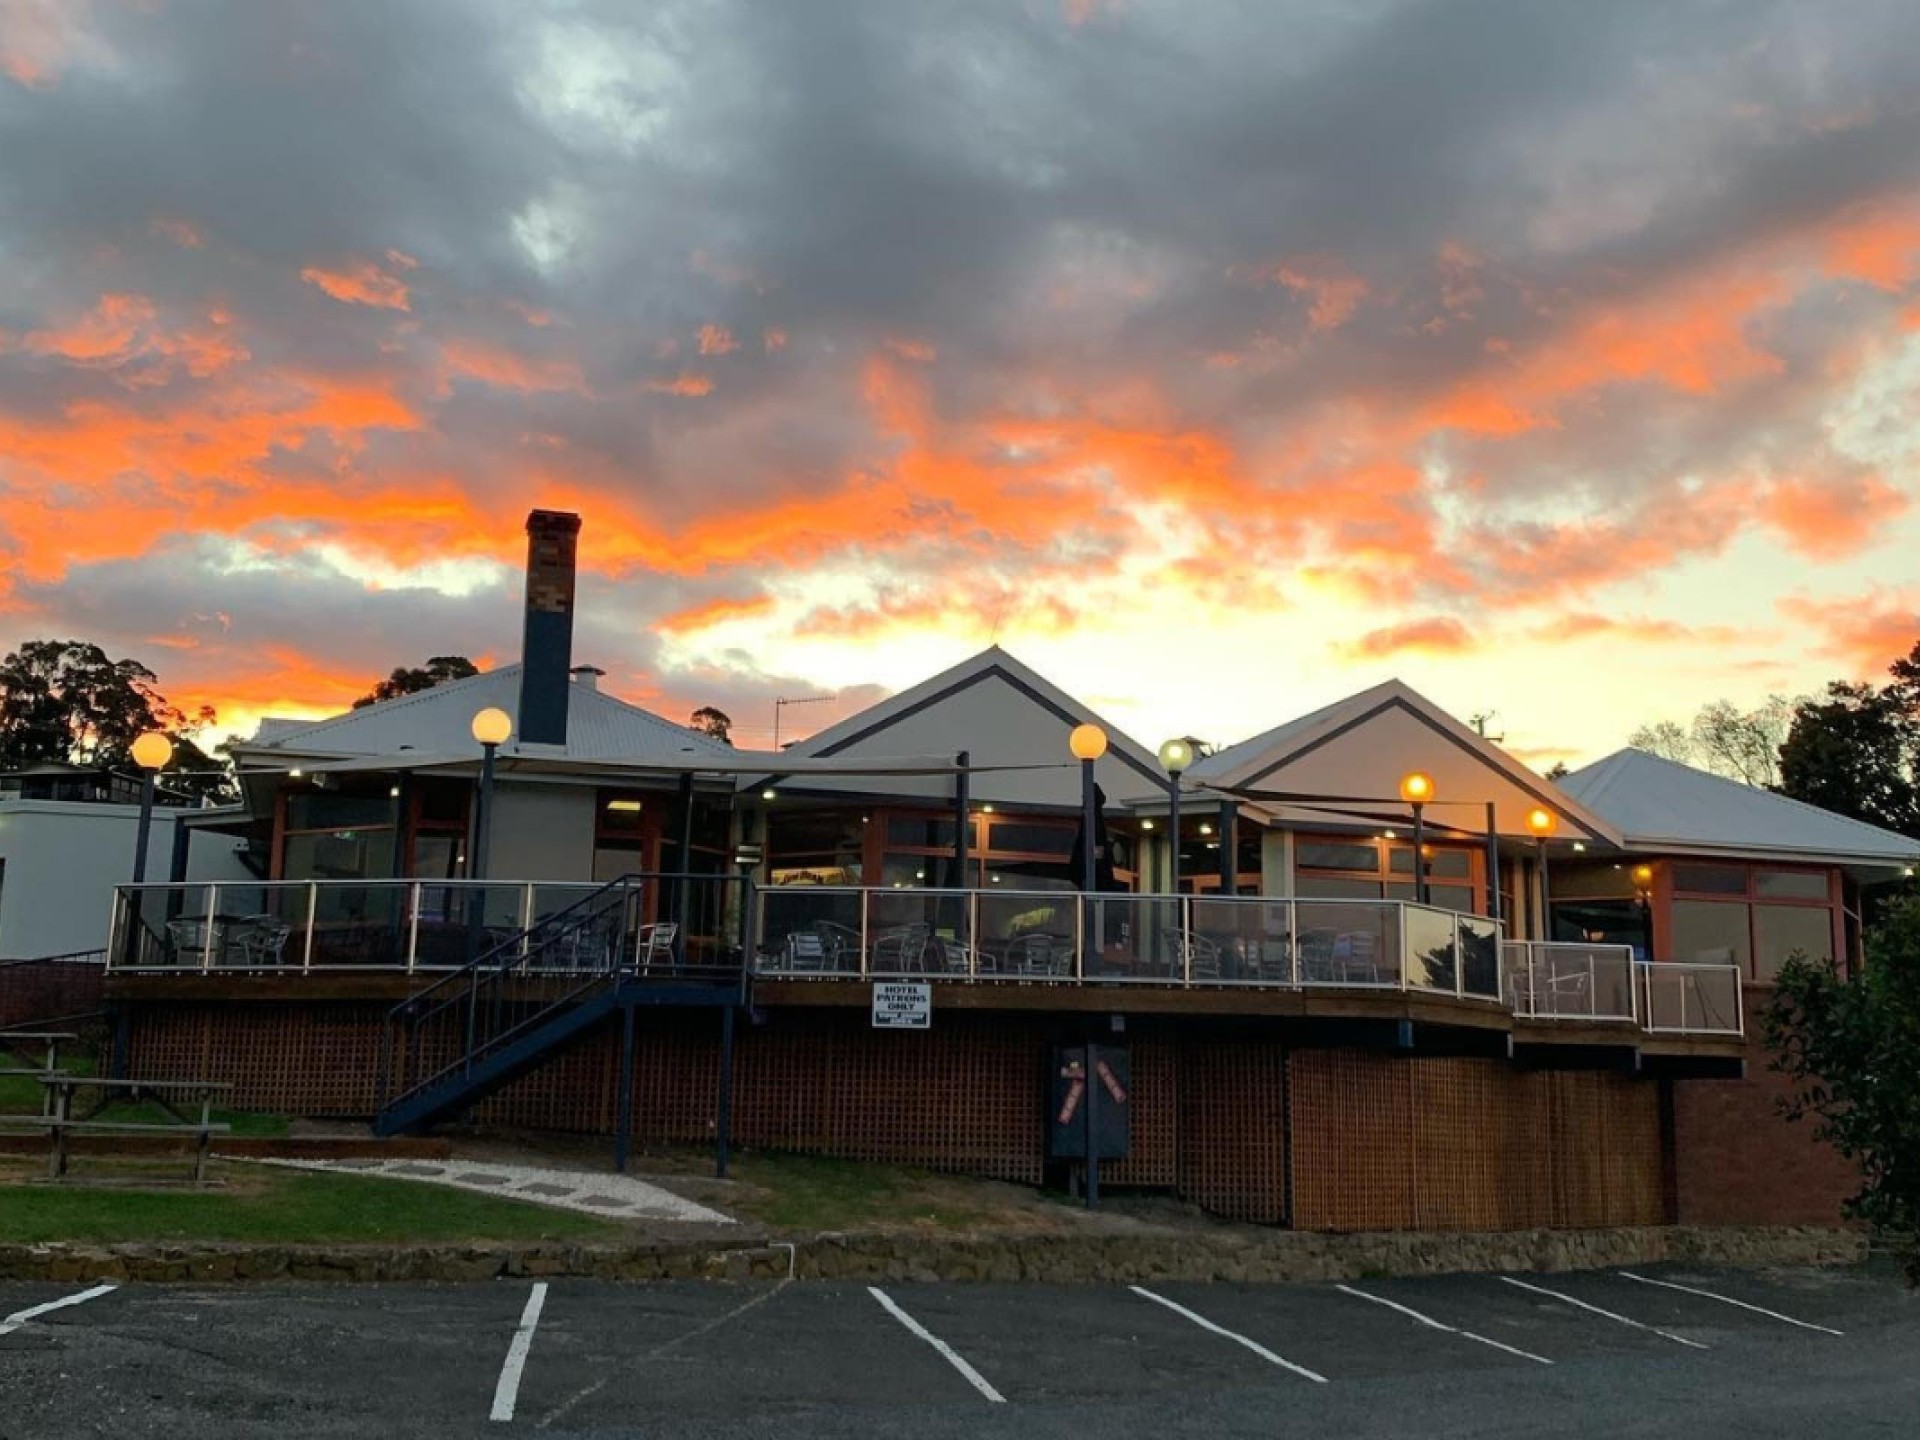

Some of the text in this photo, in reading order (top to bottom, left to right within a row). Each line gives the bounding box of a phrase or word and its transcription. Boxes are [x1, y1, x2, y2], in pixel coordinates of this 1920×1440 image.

[884, 986, 917, 994] HOTEL
[876, 994, 926, 1002] PATRONS
[887, 1002, 915, 1010] ONLY
